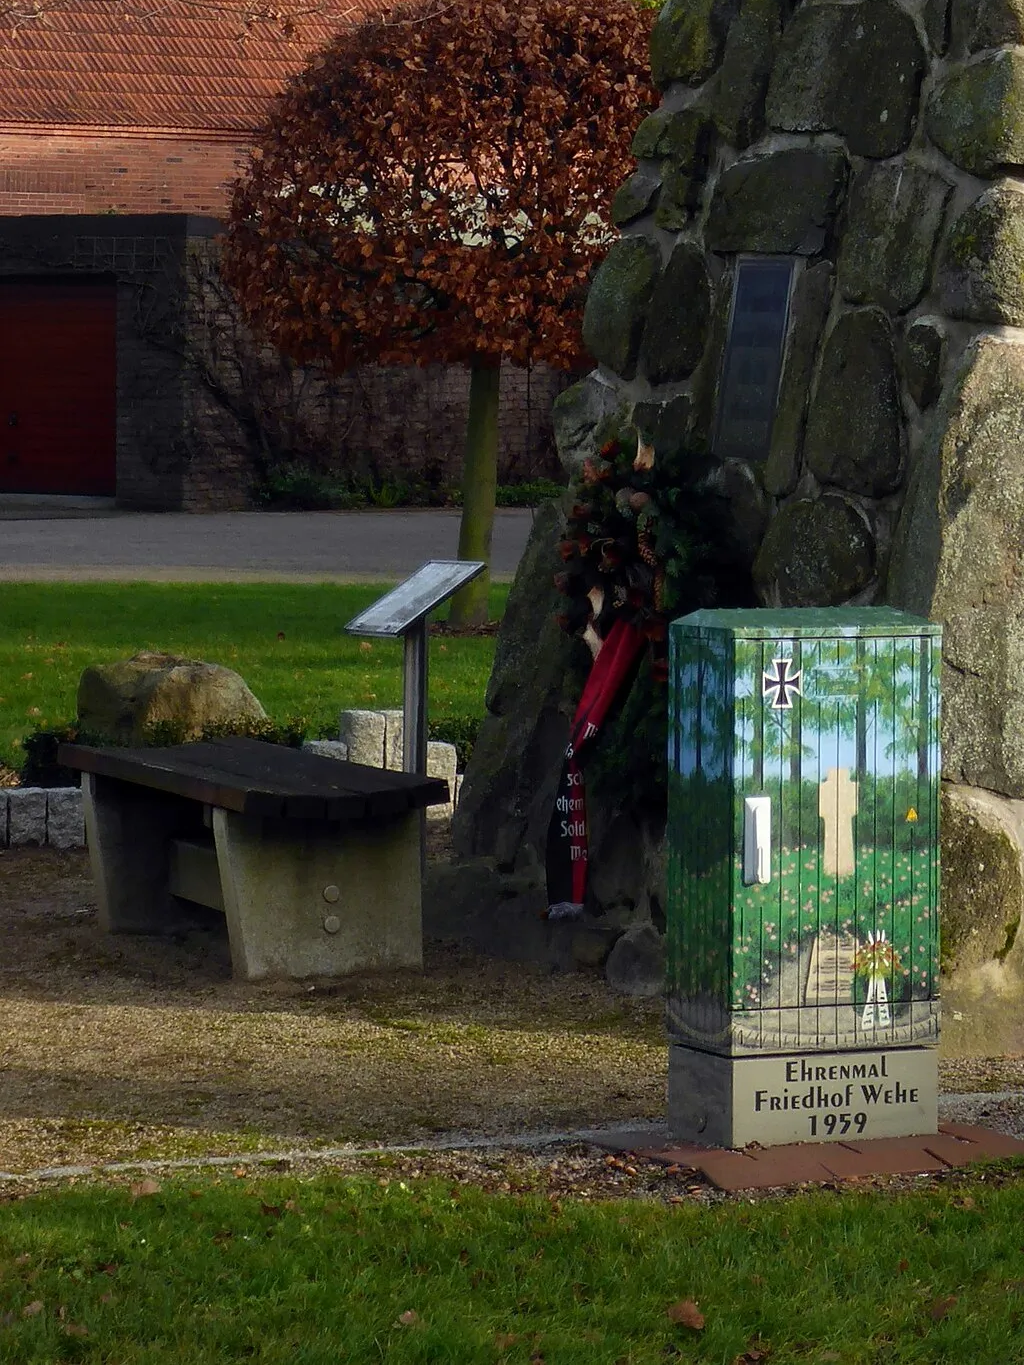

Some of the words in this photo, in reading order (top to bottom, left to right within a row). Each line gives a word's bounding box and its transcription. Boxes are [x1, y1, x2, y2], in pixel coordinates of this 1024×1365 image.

[786, 1055, 888, 1082] Ehrenmal
[755, 1084, 854, 1111] Friedhof
[861, 1082, 919, 1104] Wehe
[808, 1112, 867, 1135] 1959
